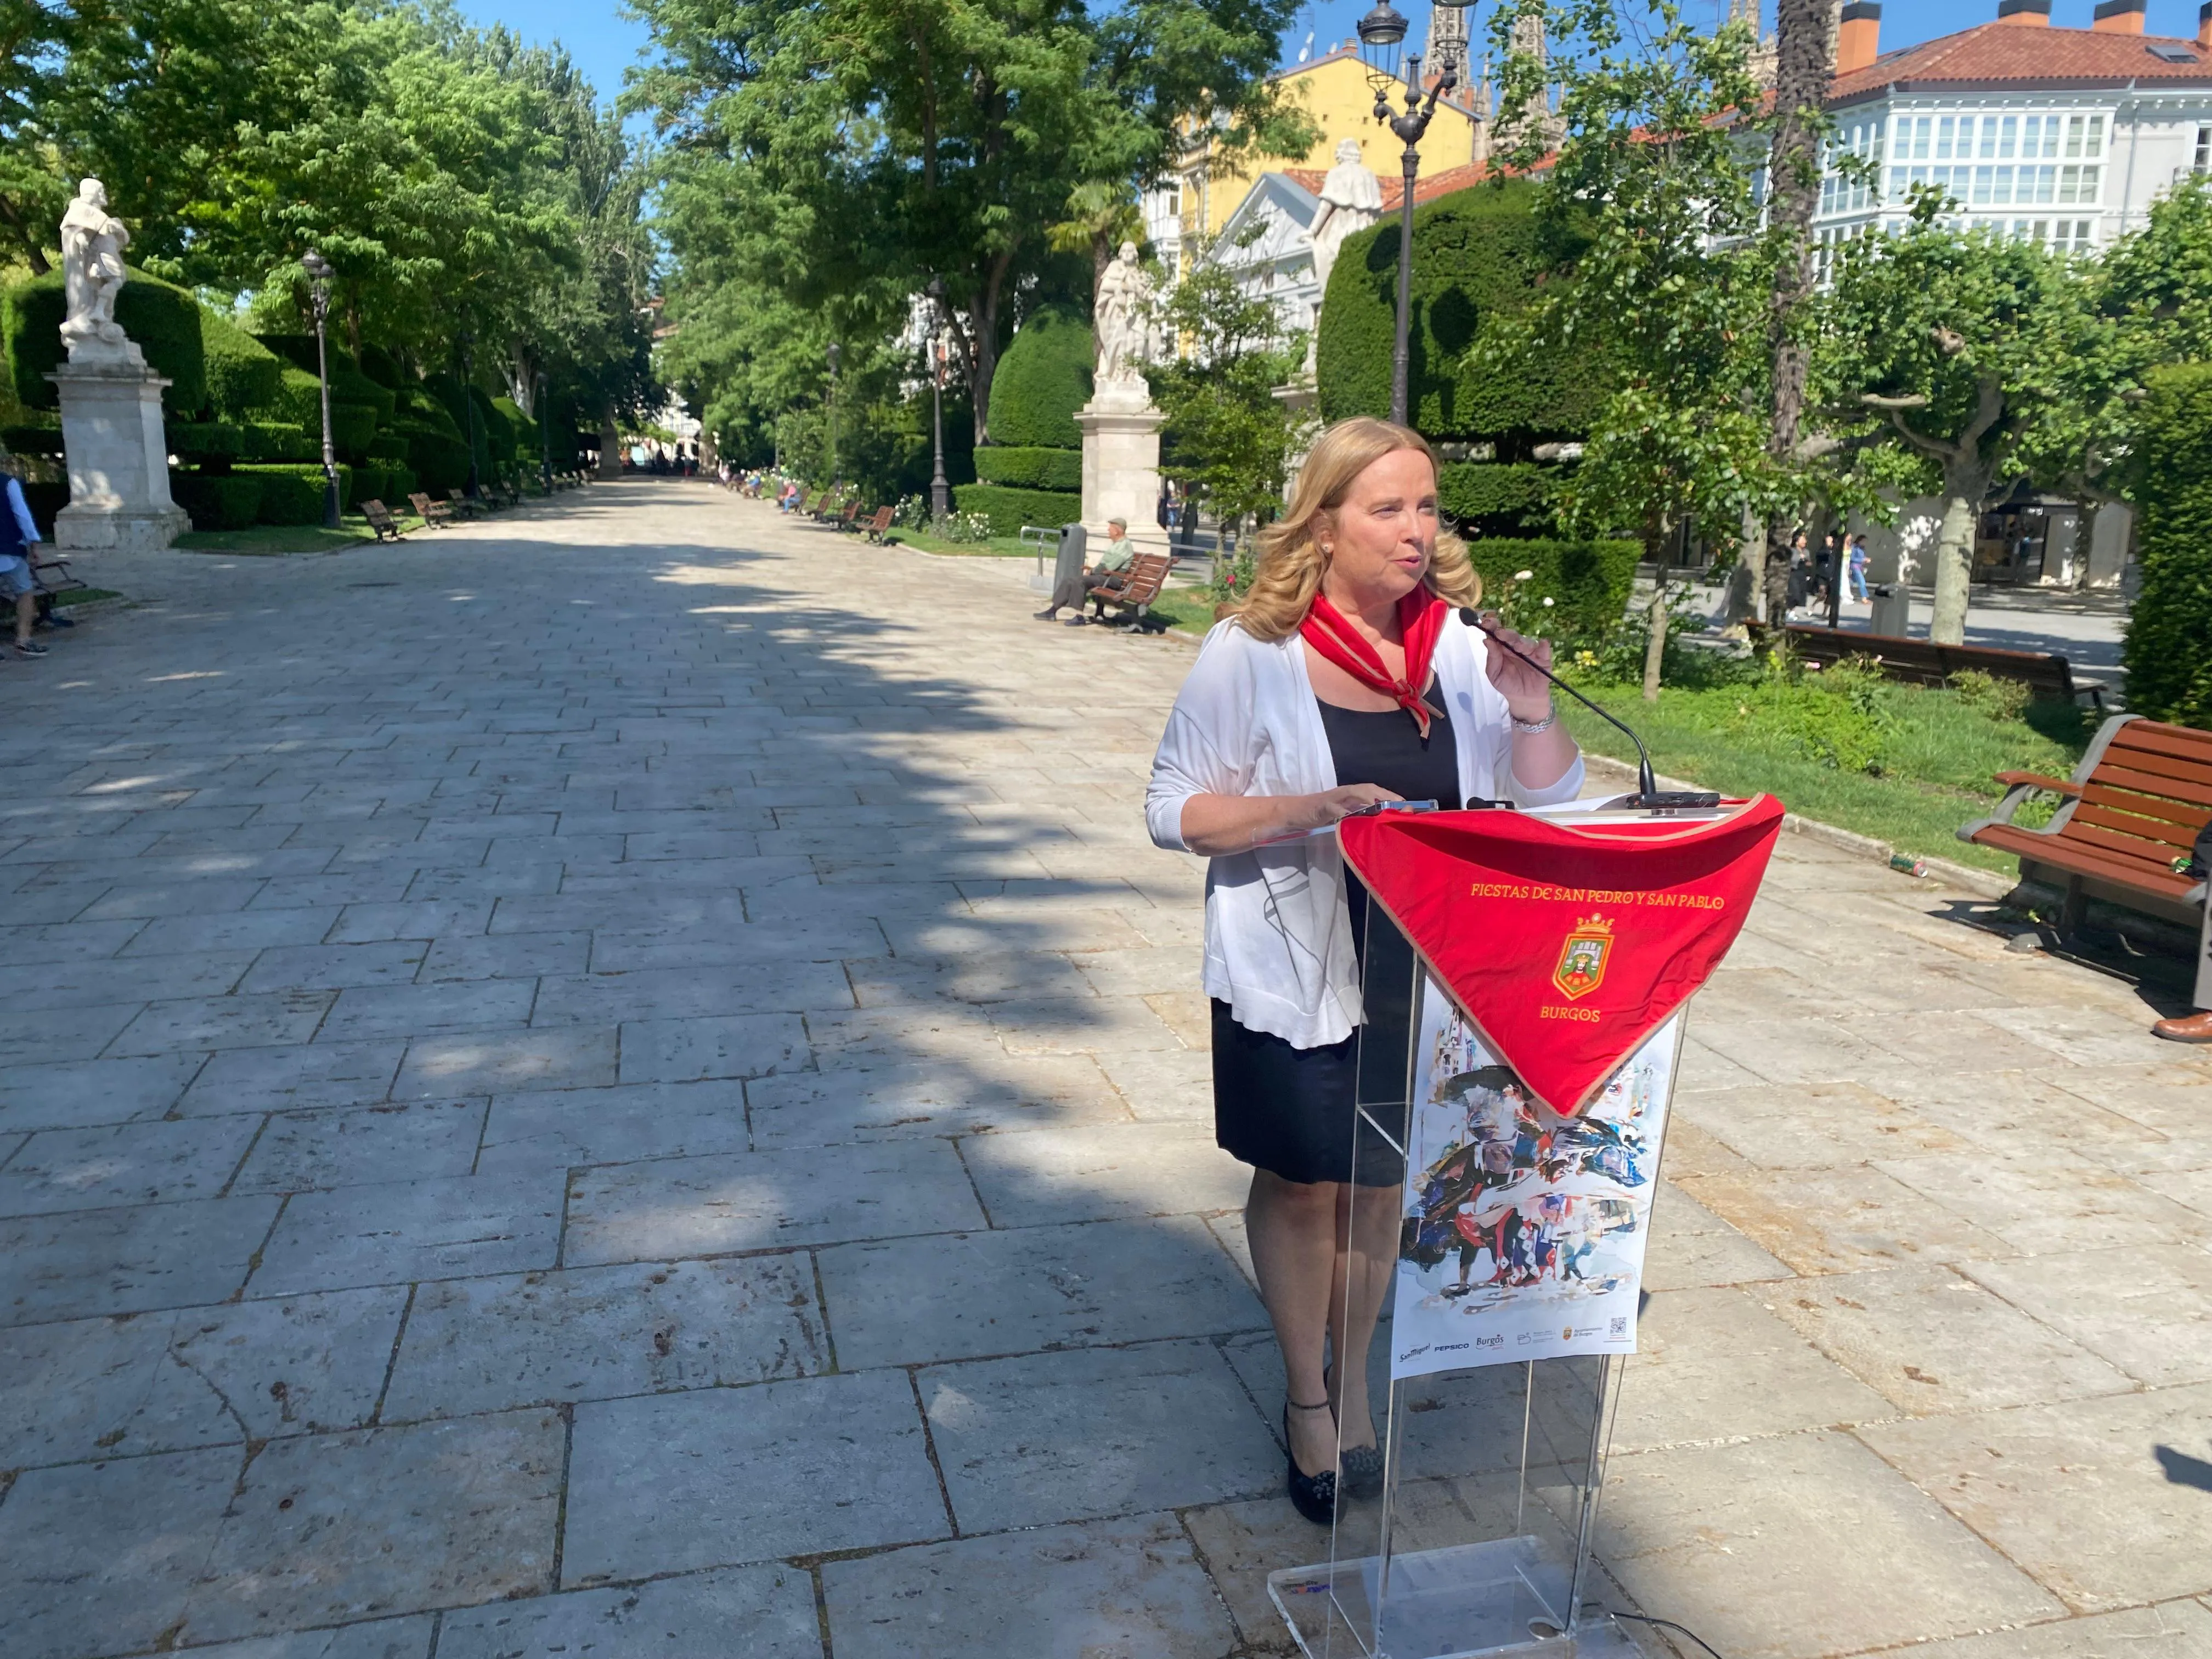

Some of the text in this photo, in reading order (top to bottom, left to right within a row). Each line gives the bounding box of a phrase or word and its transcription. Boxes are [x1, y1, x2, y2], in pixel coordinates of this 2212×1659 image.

[1471, 883, 1725, 910] FIESTAS DE SAN PEDRO Y SAN PABLO
[1540, 1006, 1601, 1023] BURGOS
[1434, 1343, 1470, 1352] PEPSICO
[1476, 1336, 1504, 1346] Burgos
